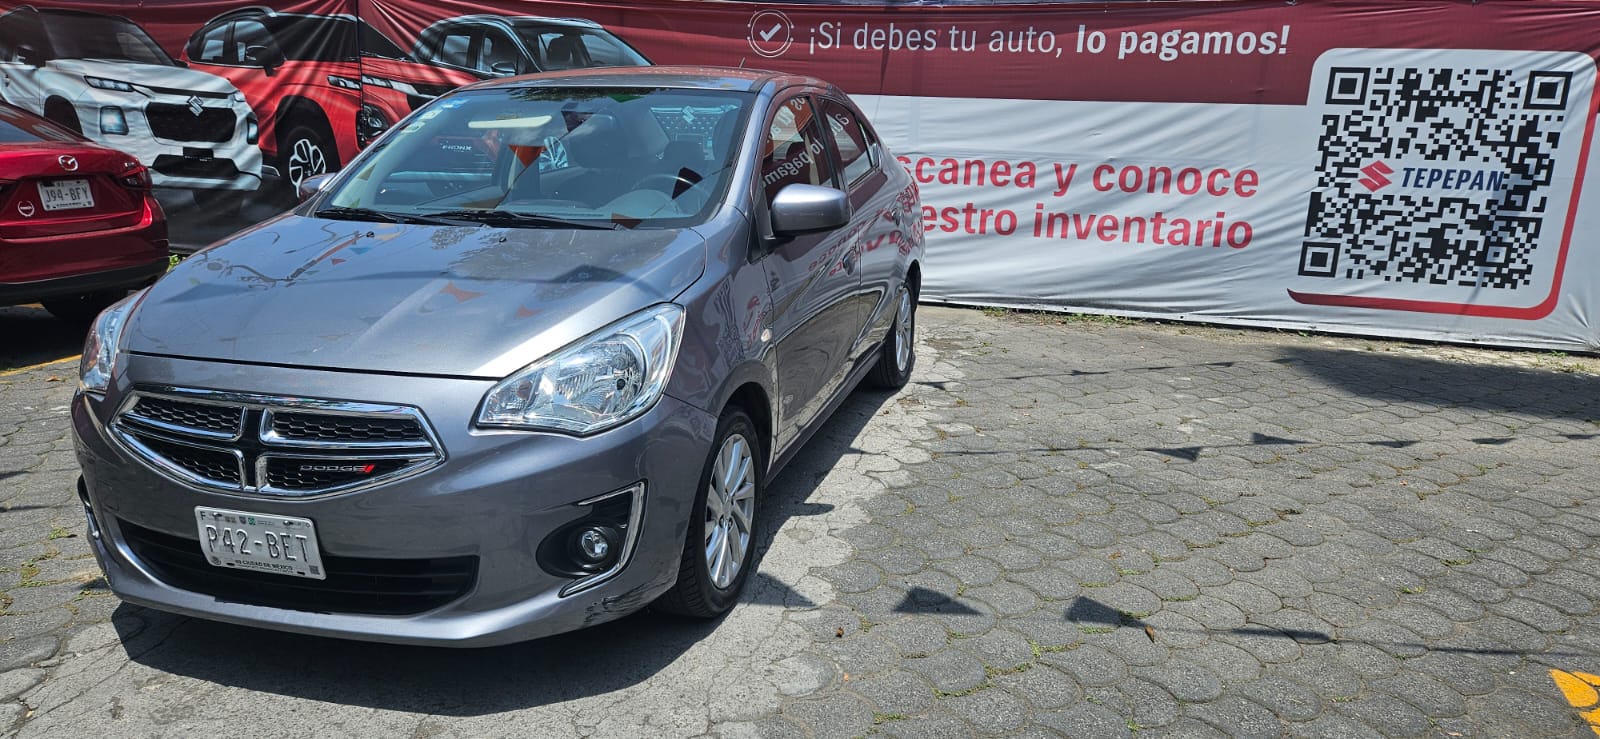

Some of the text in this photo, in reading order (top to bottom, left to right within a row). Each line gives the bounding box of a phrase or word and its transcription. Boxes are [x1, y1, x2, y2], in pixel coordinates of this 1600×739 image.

[809, 22, 1291, 62] ¡Si debes tu auto, lo pagamos!
[1053, 163, 1077, 197] y
[1092, 164, 1259, 198] conoce
[1401, 167, 1505, 192] TEPEPAN
[921, 202, 1253, 249] estro inventario
[299, 464, 366, 473] DODGE
[204, 524, 309, 563] P42-BET
